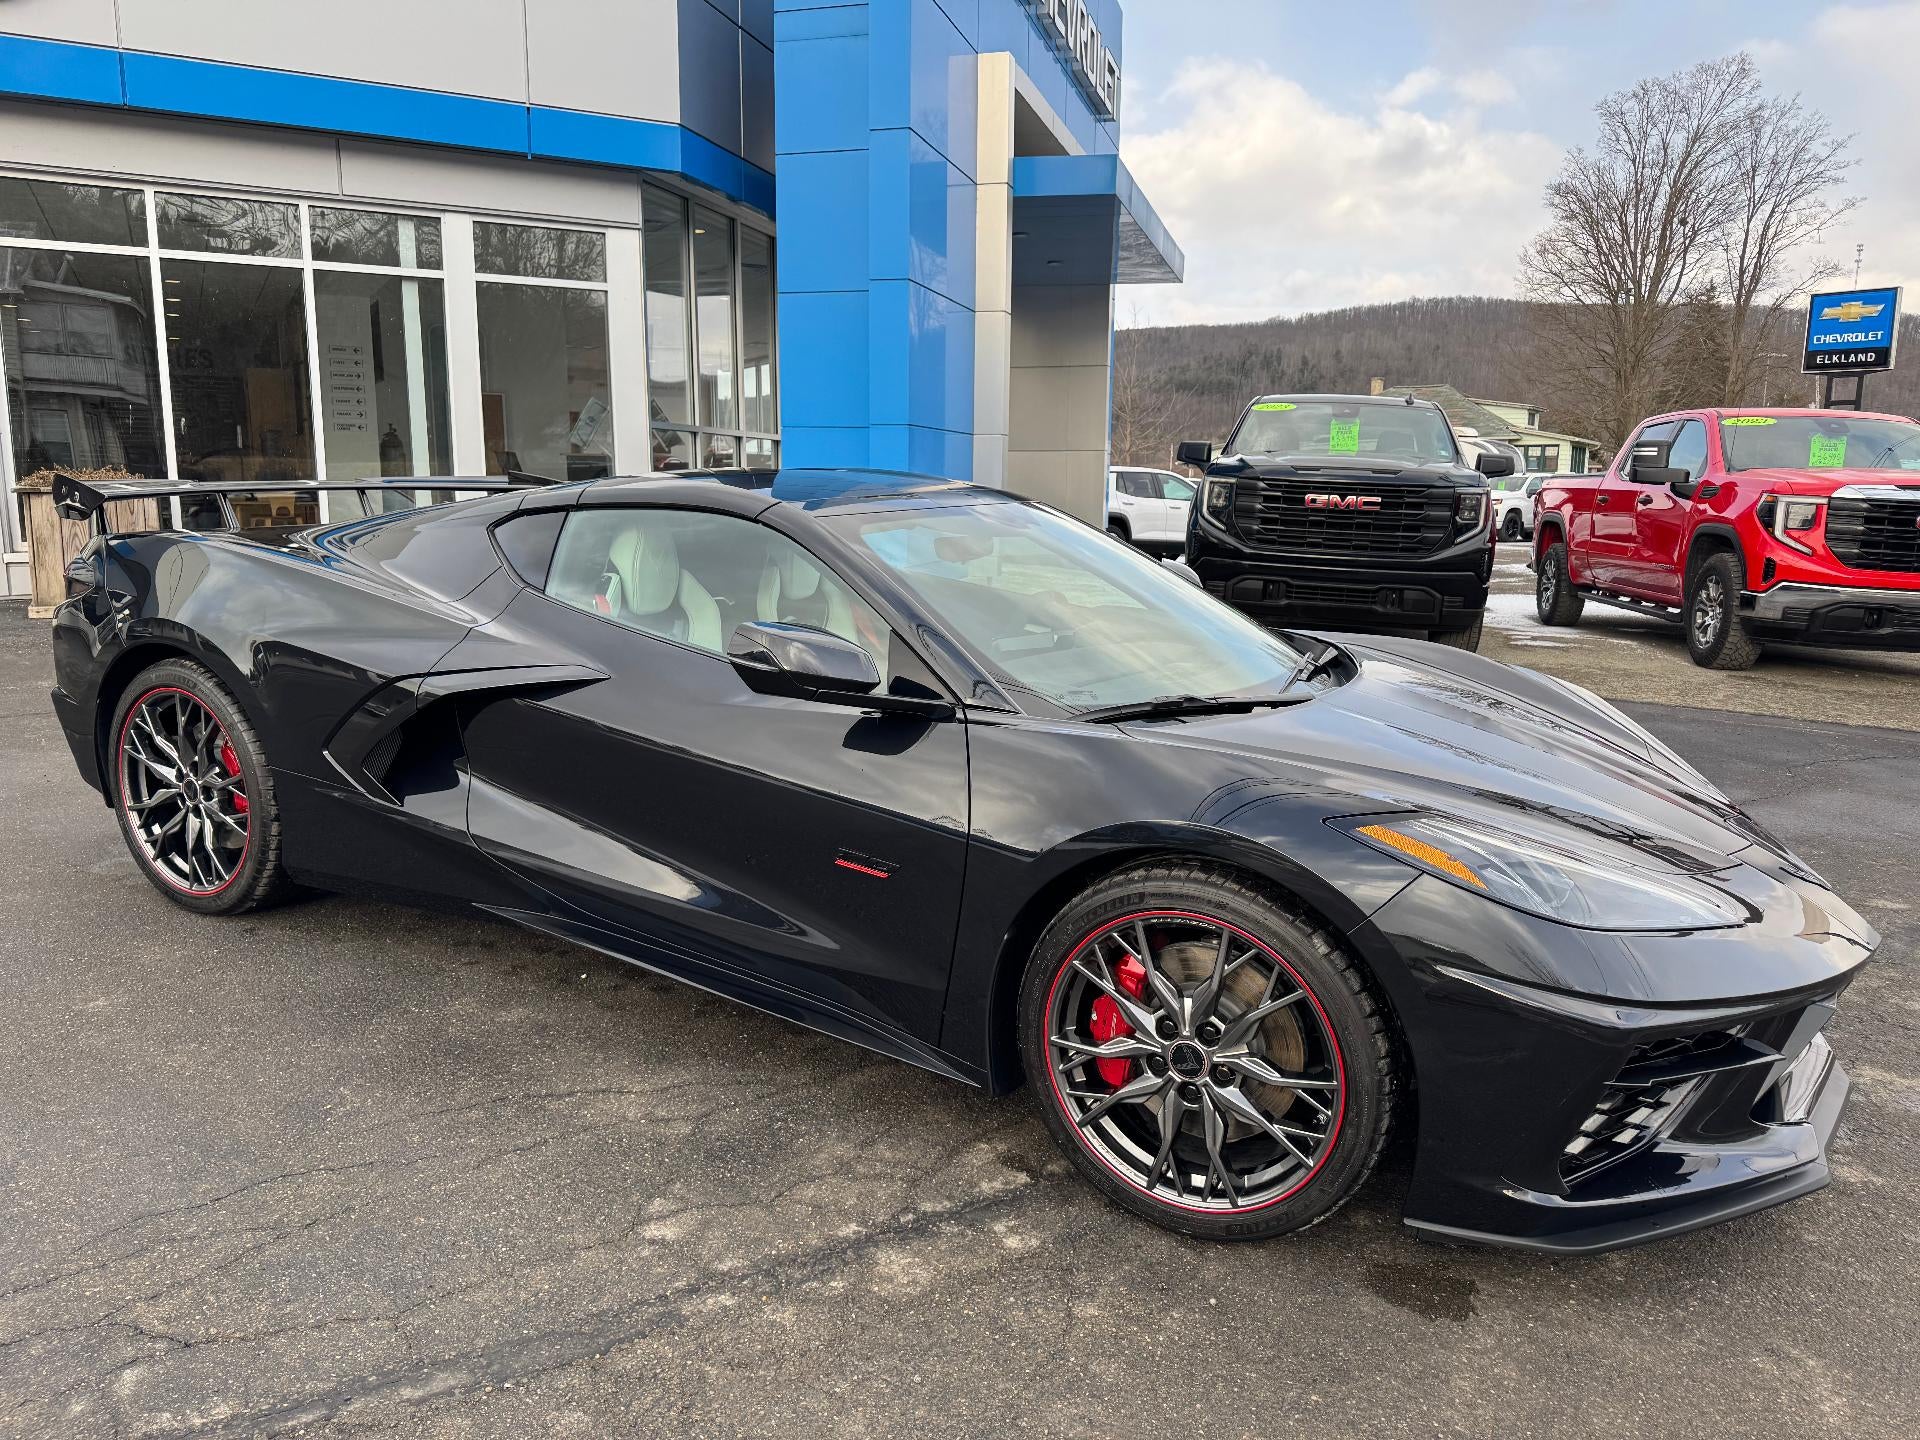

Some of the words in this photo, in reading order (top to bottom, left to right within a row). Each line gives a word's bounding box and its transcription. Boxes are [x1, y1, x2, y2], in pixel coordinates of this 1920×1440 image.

[1042, 0, 1120, 121] VROLET
[1814, 331, 1884, 344] CHEVROLET
[1816, 352, 1876, 364] ELKLAND
[1305, 493, 1382, 511] GMC
